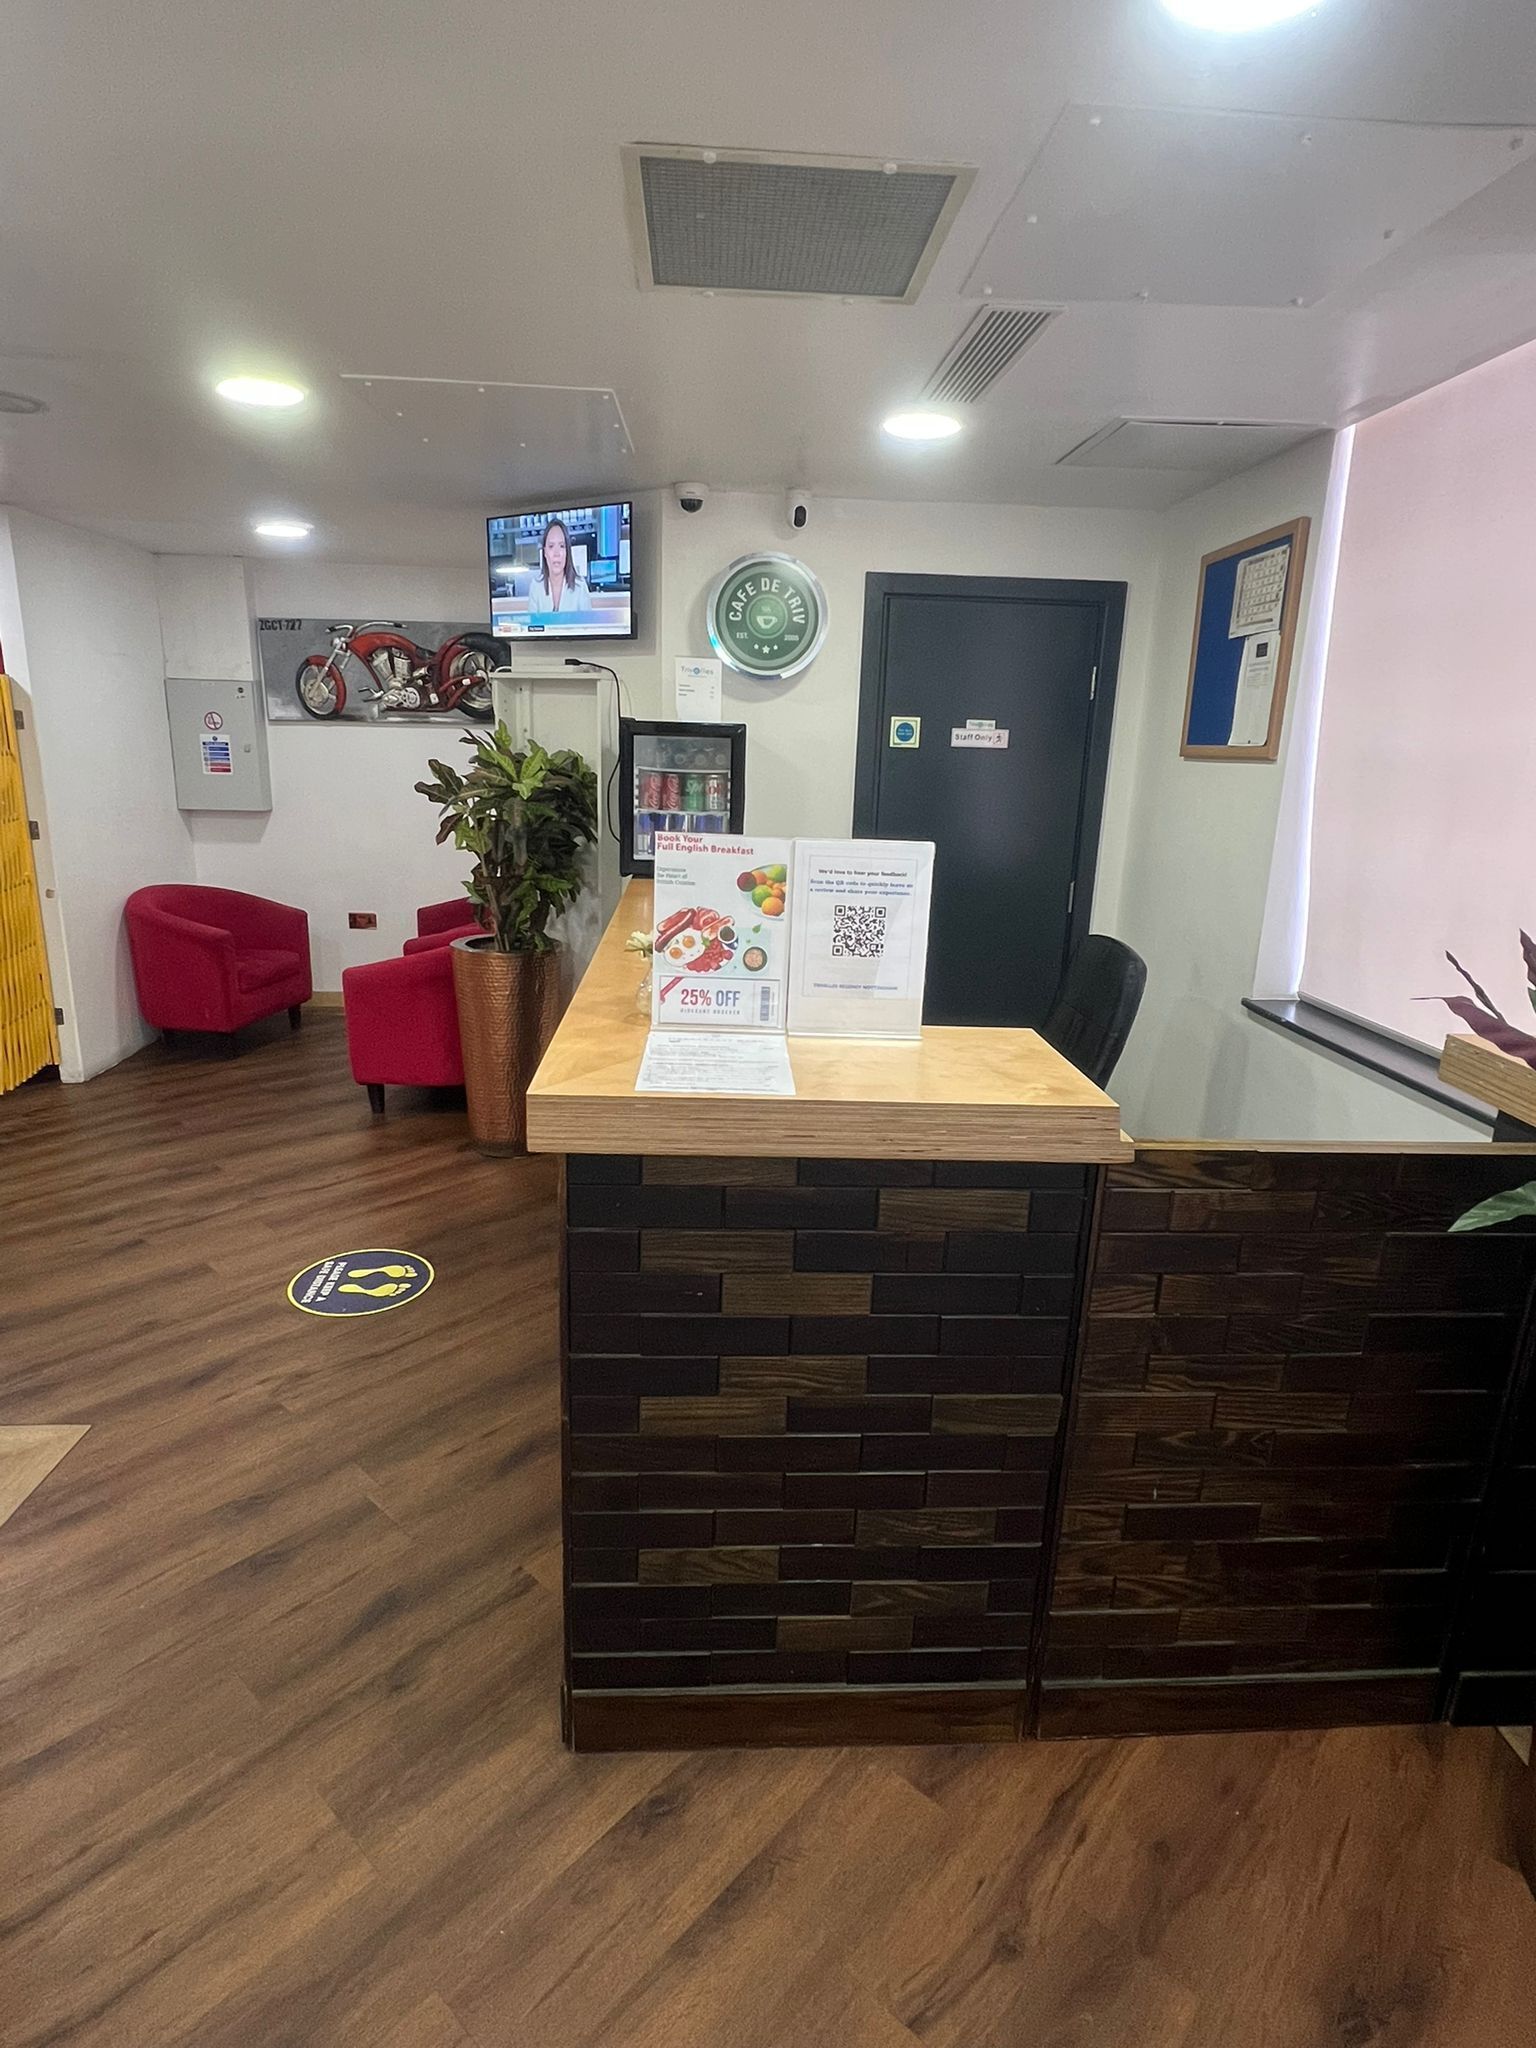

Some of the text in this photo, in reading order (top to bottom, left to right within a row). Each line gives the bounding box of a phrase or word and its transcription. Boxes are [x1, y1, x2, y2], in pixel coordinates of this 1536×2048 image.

[729, 577, 805, 624] CAFE DE TRIV
[974, 734, 993, 742] Only
[657, 834, 703, 843] Book Your
[657, 843, 754, 855] Full English Breakfast
[681, 989, 741, 1007] 25% OFF
[320, 1281, 336, 1296] KEEP
